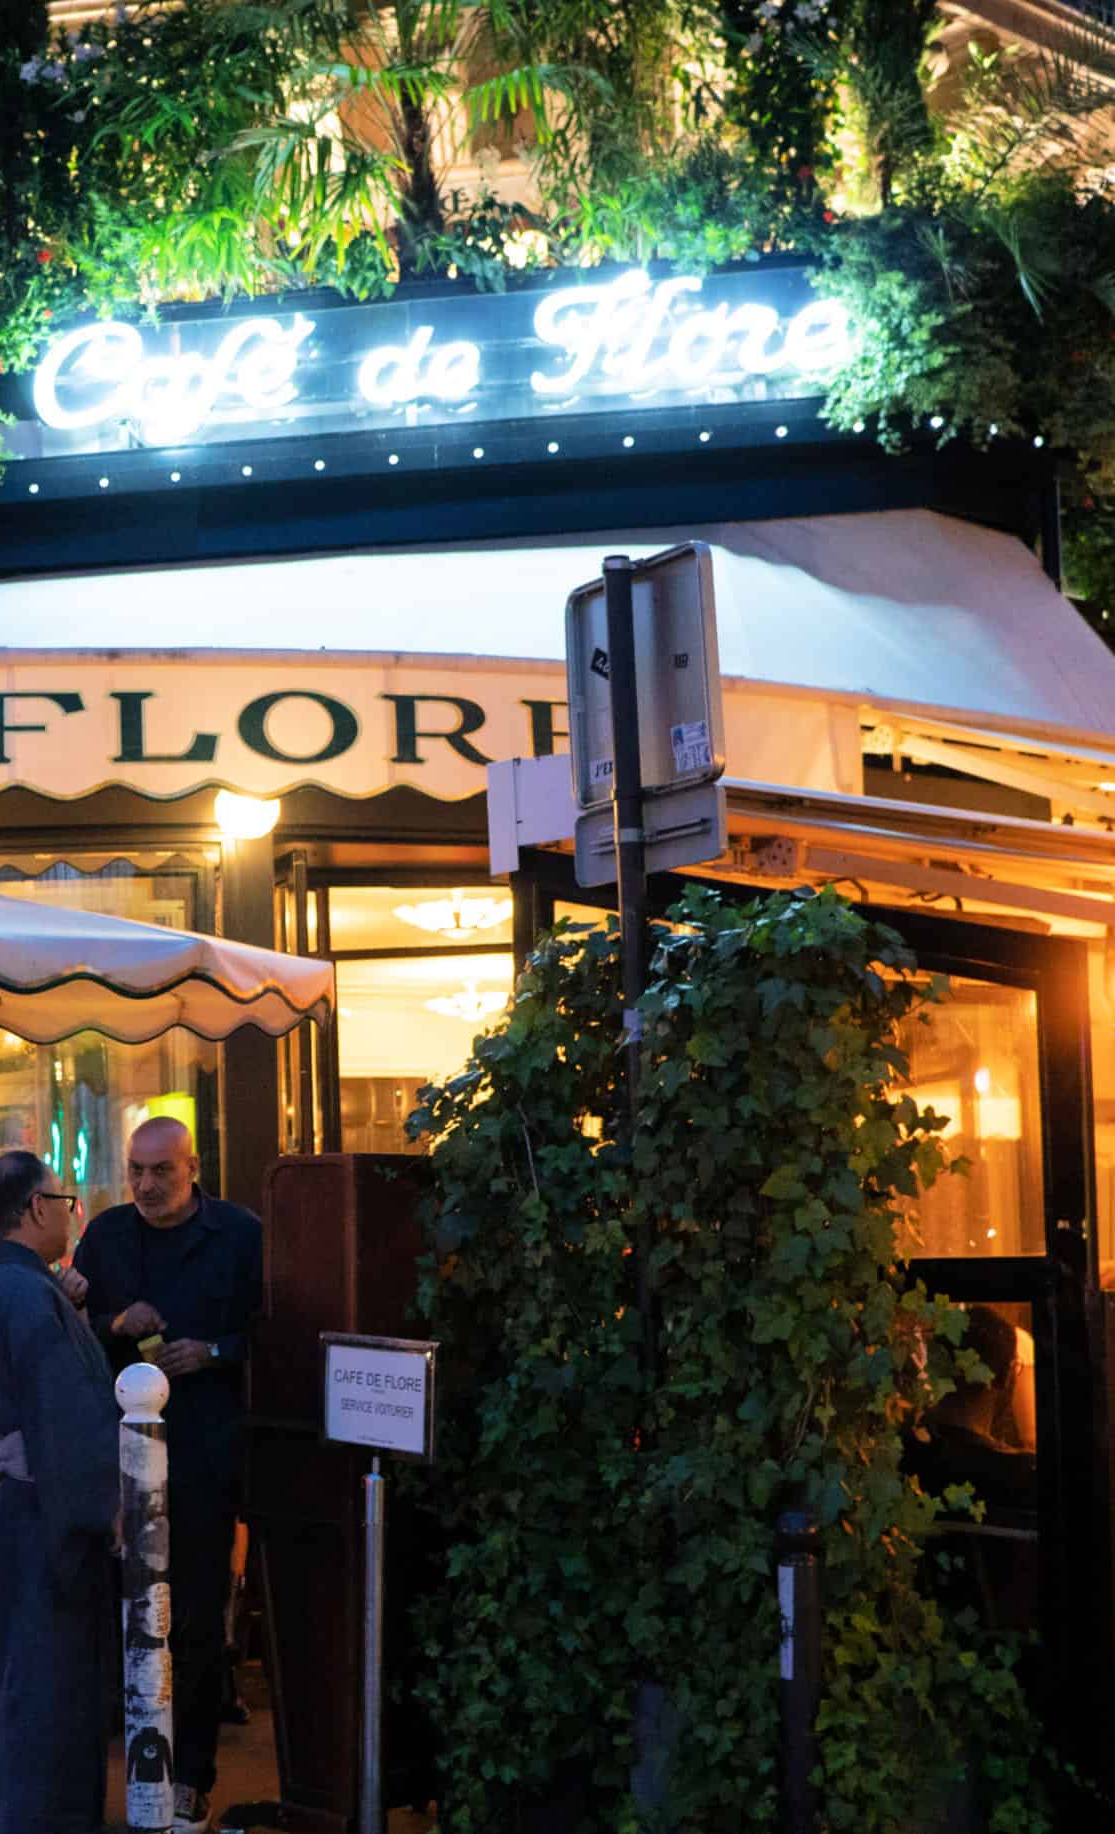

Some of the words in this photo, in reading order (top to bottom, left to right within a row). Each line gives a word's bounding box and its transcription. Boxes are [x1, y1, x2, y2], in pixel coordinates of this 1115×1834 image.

[33, 312, 316, 446] Café
[358, 325, 481, 405] de
[531, 268, 857, 396] Flore
[334, 1369, 363, 1385] CAFE
[365, 1373, 382, 1388] DE
[385, 1375, 422, 1392] FLORE
[341, 1397, 373, 1415] SERVICE
